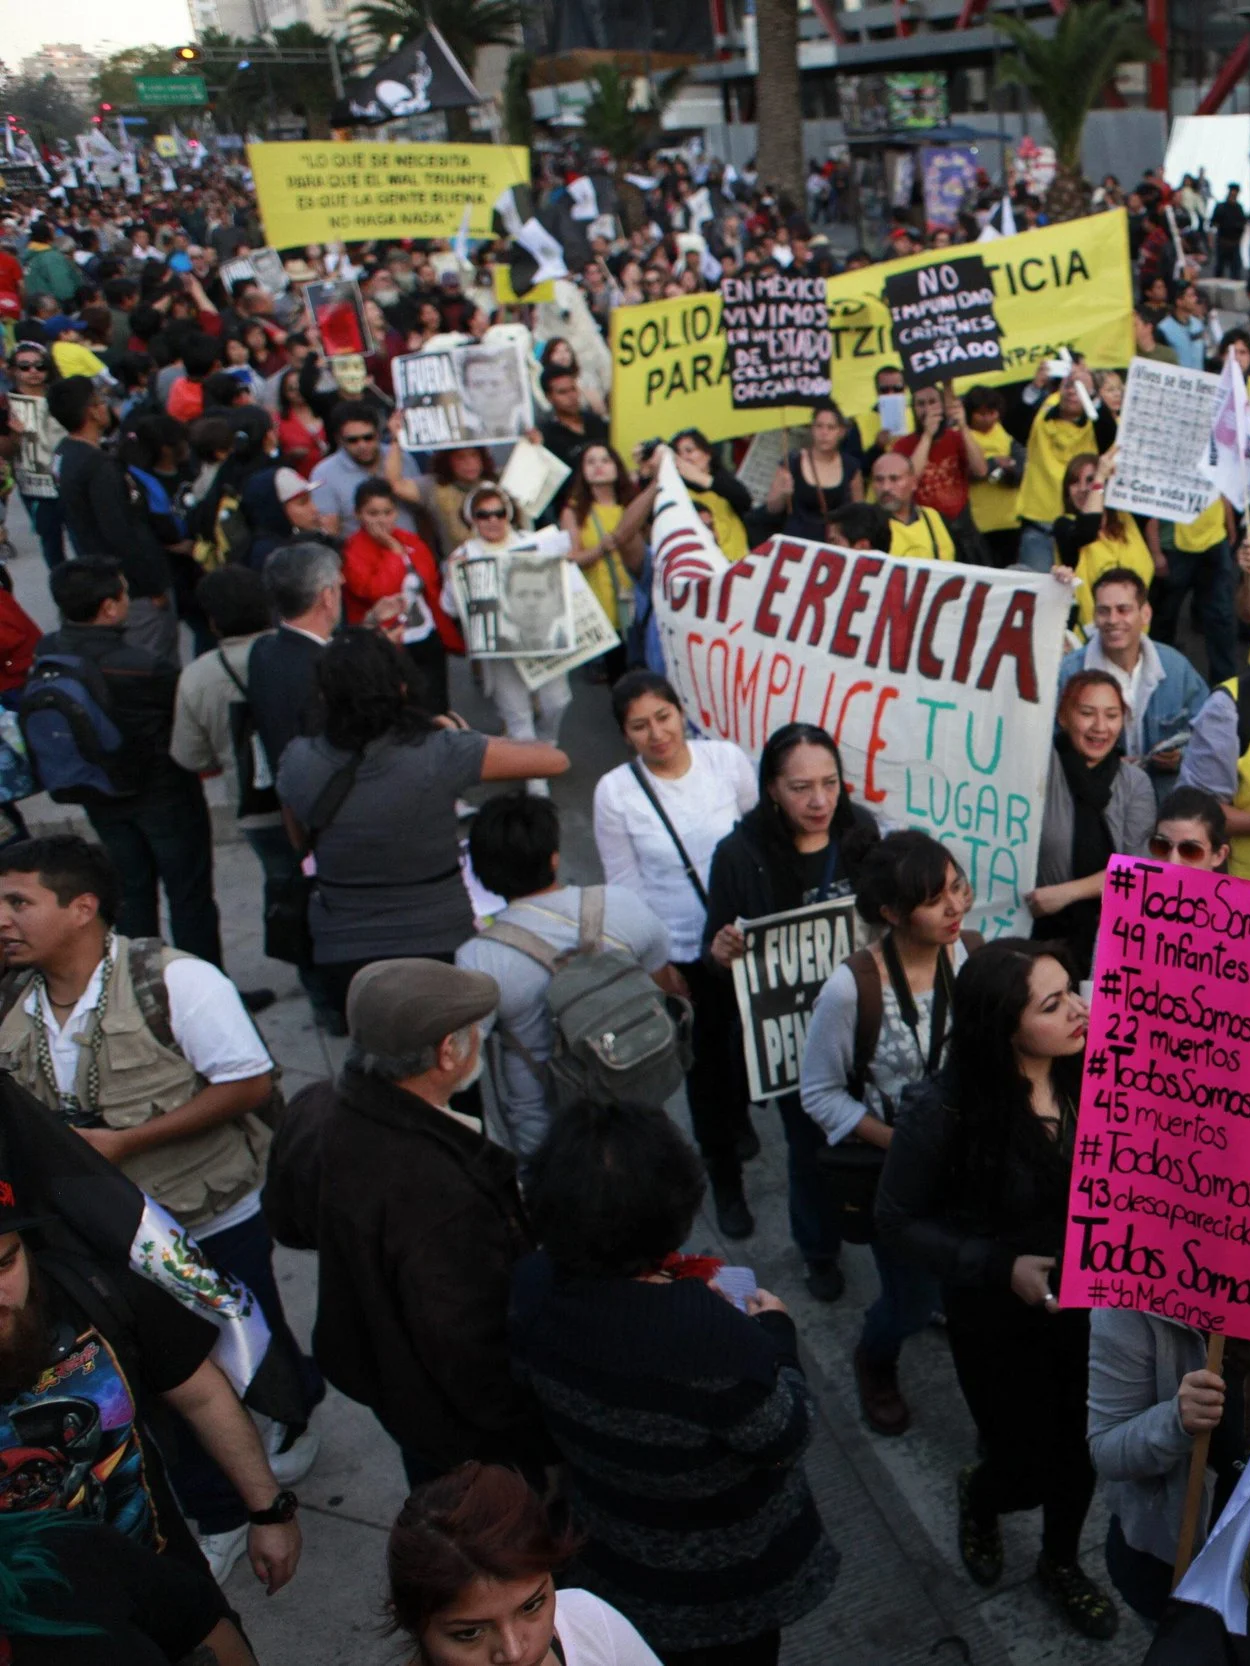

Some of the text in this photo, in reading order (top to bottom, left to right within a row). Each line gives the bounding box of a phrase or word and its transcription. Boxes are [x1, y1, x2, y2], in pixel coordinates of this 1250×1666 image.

[331, 153, 364, 169] QUE
[371, 154, 390, 168] SE
[395, 153, 472, 168] NECESITA
[287, 175, 325, 189] PARA
[329, 174, 360, 188] QUE
[363, 175, 382, 188] EL
[387, 174, 421, 187] MAL
[296, 192, 486, 210] ES QUE LA GENTE BUENA
[328, 215, 351, 229] NO
[355, 213, 397, 227] HAGA
[721, 277, 755, 304] EN
[917, 263, 960, 297] NO
[723, 302, 829, 328] VIVIMOS
[892, 287, 994, 322] IMPUNIDAD
[734, 347, 762, 367] DE
[768, 327, 833, 361] ESTADO
[909, 339, 1000, 374] ESTADO
[732, 361, 821, 382] CRIMEN
[1130, 479, 1157, 494] Con
[1160, 486, 1186, 501] vida
[916, 696, 1003, 775] TU
[906, 766, 1031, 843] LUGAR
[1111, 916, 1146, 961] 49
[1154, 932, 1250, 984] infantes
[1104, 1013, 1241, 1072] 22 muertos
[1093, 1089, 1228, 1151] 45 muertos
[1077, 1174, 1111, 1210] 43
[1071, 1215, 1167, 1280] Todos
